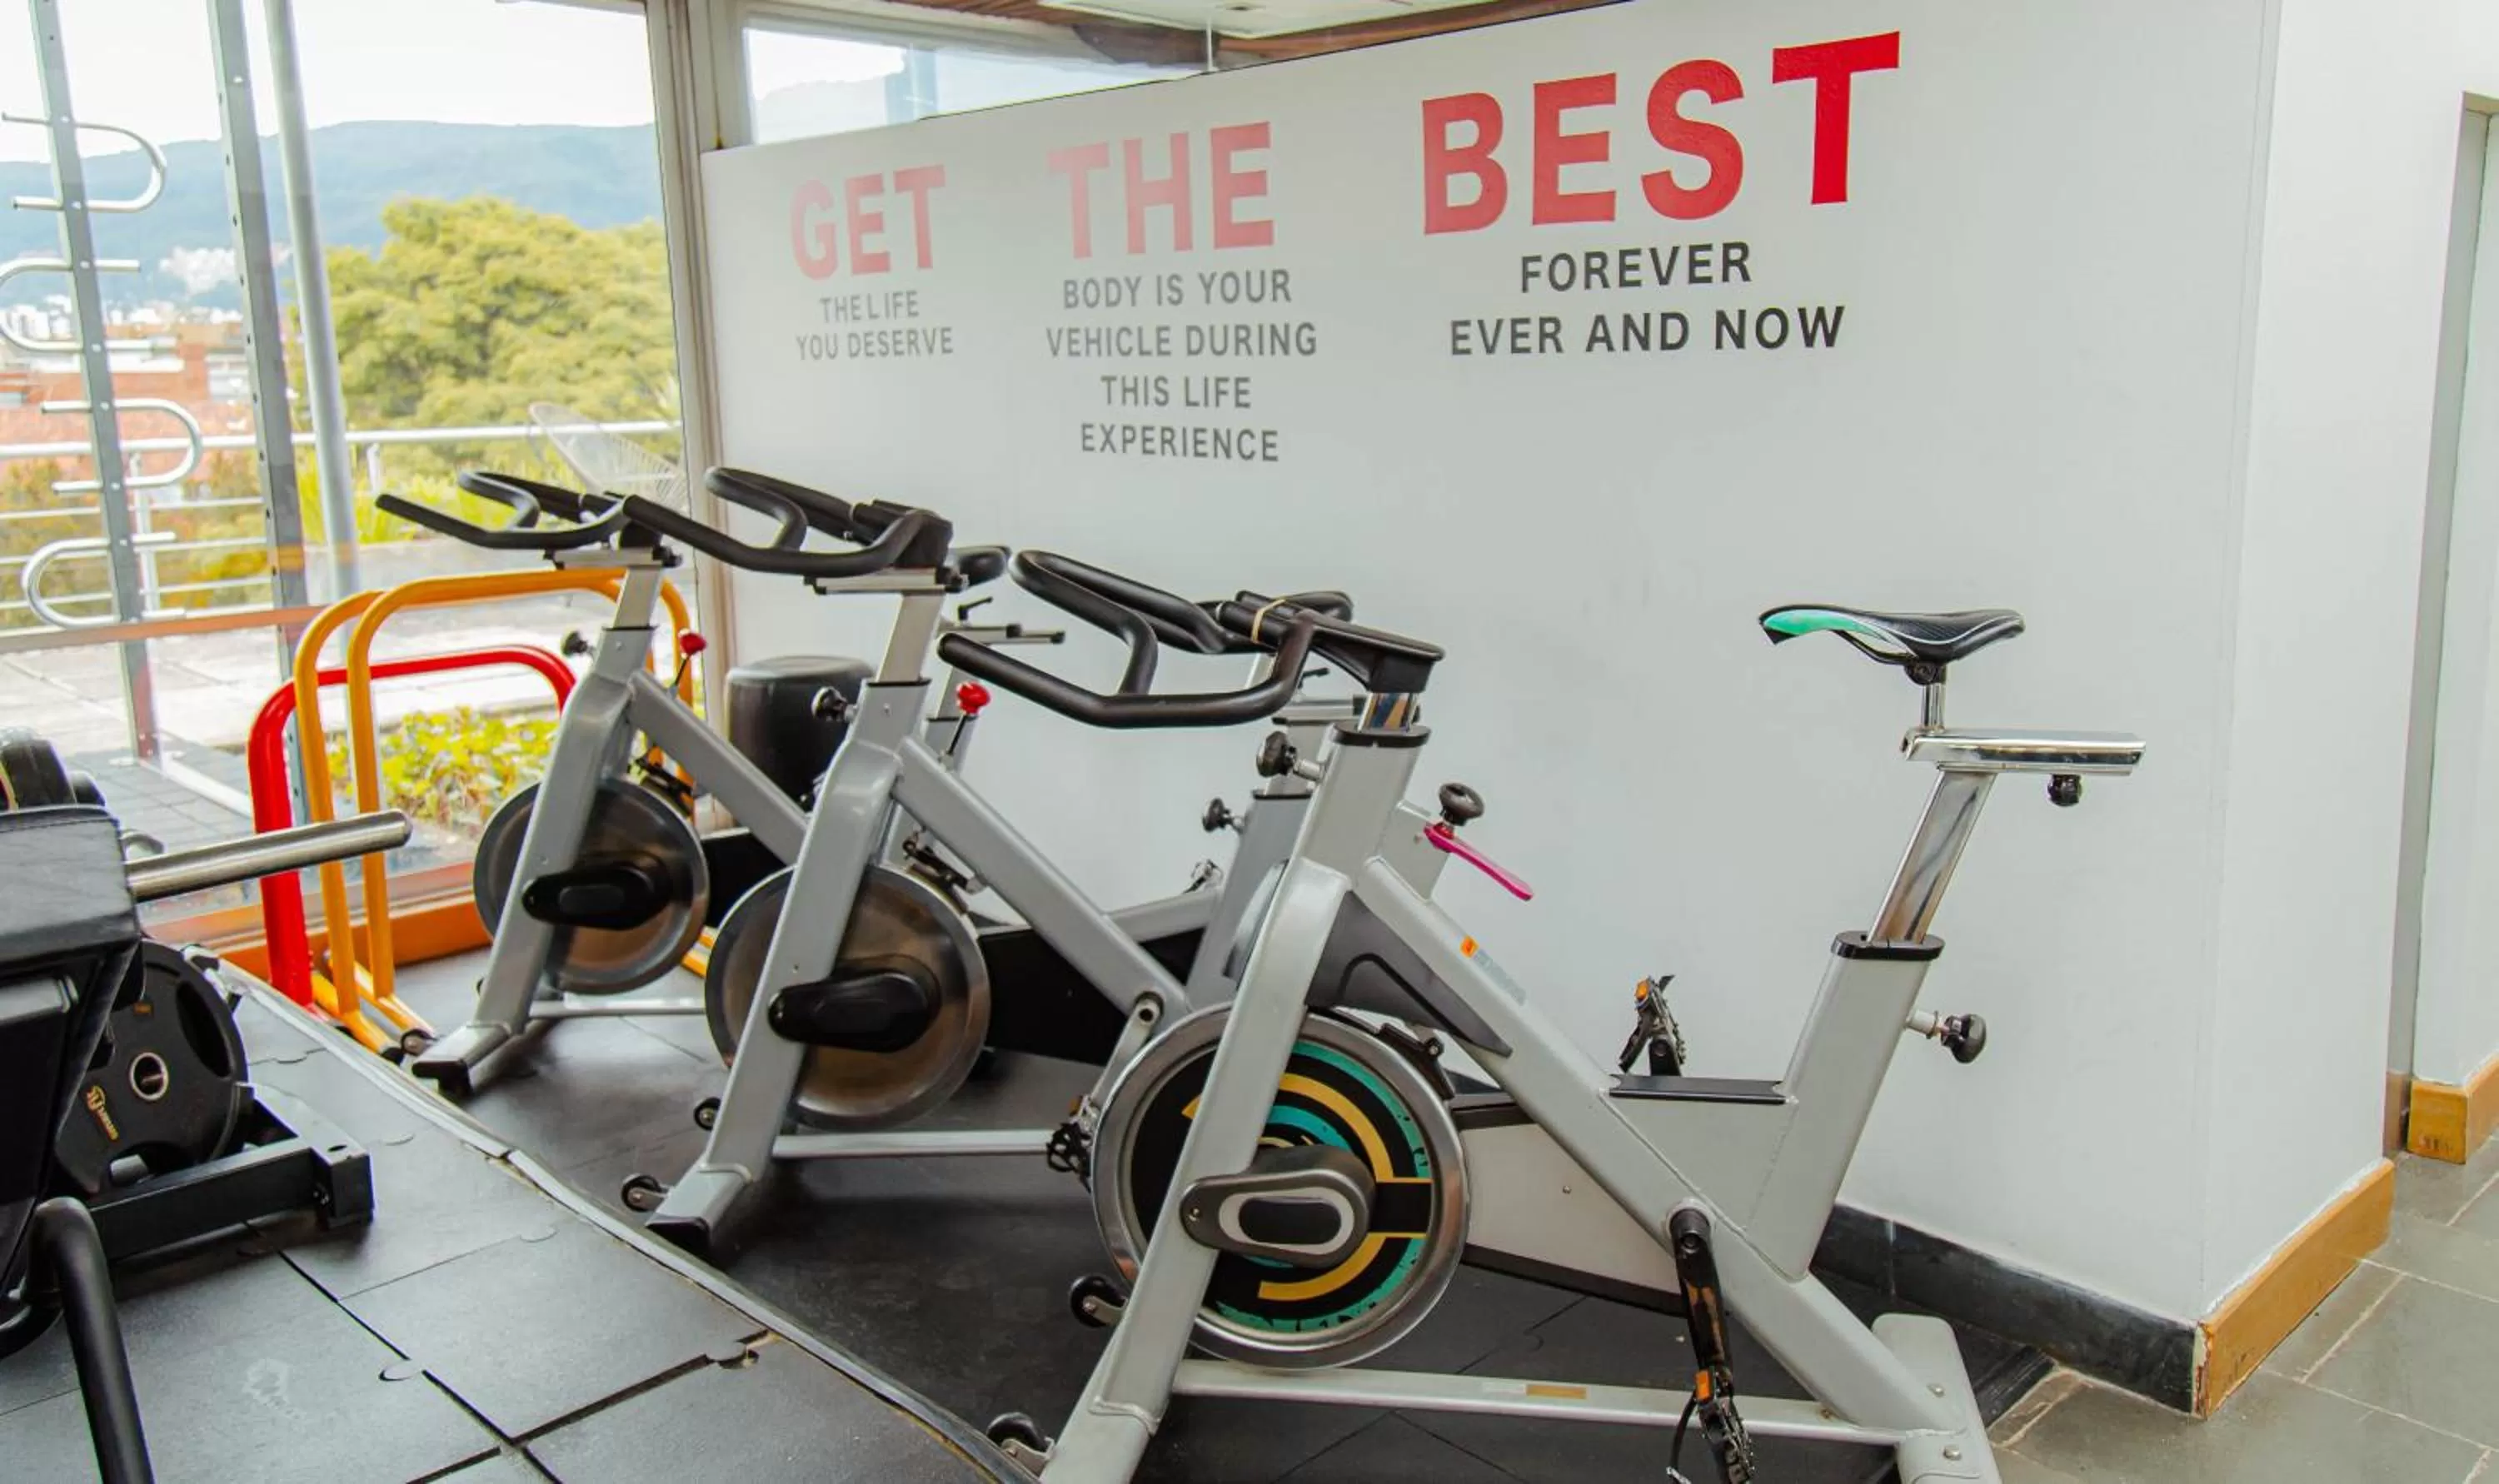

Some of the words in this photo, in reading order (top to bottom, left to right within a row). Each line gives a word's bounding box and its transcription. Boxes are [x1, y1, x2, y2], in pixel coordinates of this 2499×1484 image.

[791, 164, 946, 281] GET
[1047, 121, 1274, 259] THE
[1422, 31, 1900, 235] BEST
[1521, 242, 1752, 294] FOREVER
[1064, 276, 1142, 309] BODY
[1155, 273, 1184, 306] IS
[1198, 268, 1292, 305] YOUR
[796, 333, 839, 361] YOU
[847, 326, 954, 358] DESERVE
[1045, 324, 1172, 357] VEHICLE
[1185, 321, 1317, 356] DURING
[1450, 316, 1564, 356] EVER
[1585, 311, 1689, 353] AND
[1714, 306, 1846, 350] NOW
[1100, 375, 1170, 407] THIS
[1184, 376, 1251, 408] LIFE
[1080, 422, 1279, 461] EXPERIENCE
